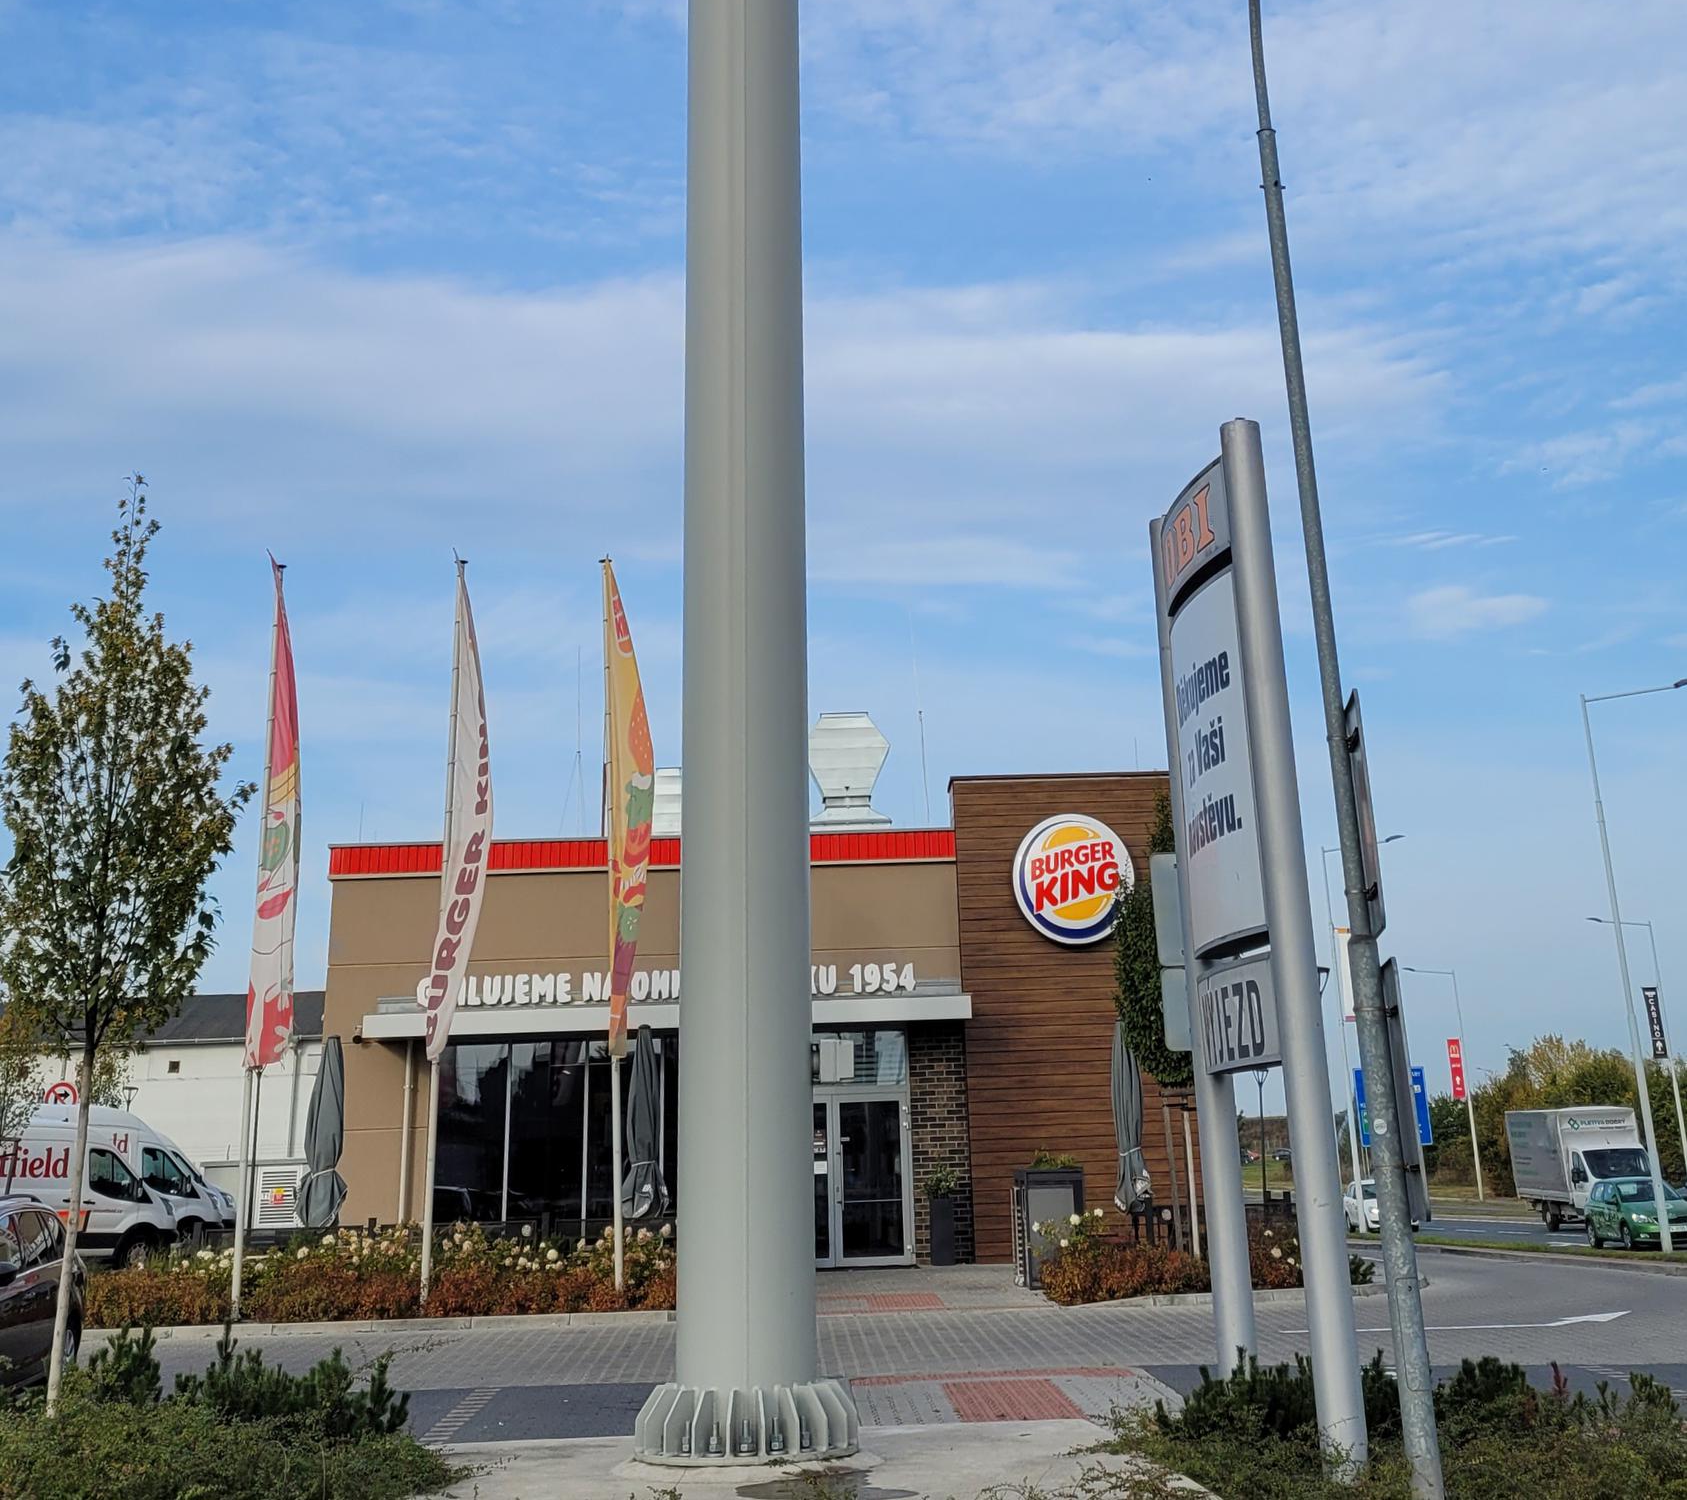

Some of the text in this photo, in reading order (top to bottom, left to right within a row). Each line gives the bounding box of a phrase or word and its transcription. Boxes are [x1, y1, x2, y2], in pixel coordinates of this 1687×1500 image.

[1193, 715, 1227, 778] Vaši
[1030, 841, 1115, 882] BURGER
[1035, 861, 1120, 913] KING
[416, 972, 572, 1008] GILUJEME
[848, 962, 917, 993] 1954
[1648, 998, 1661, 1038] CASINO
